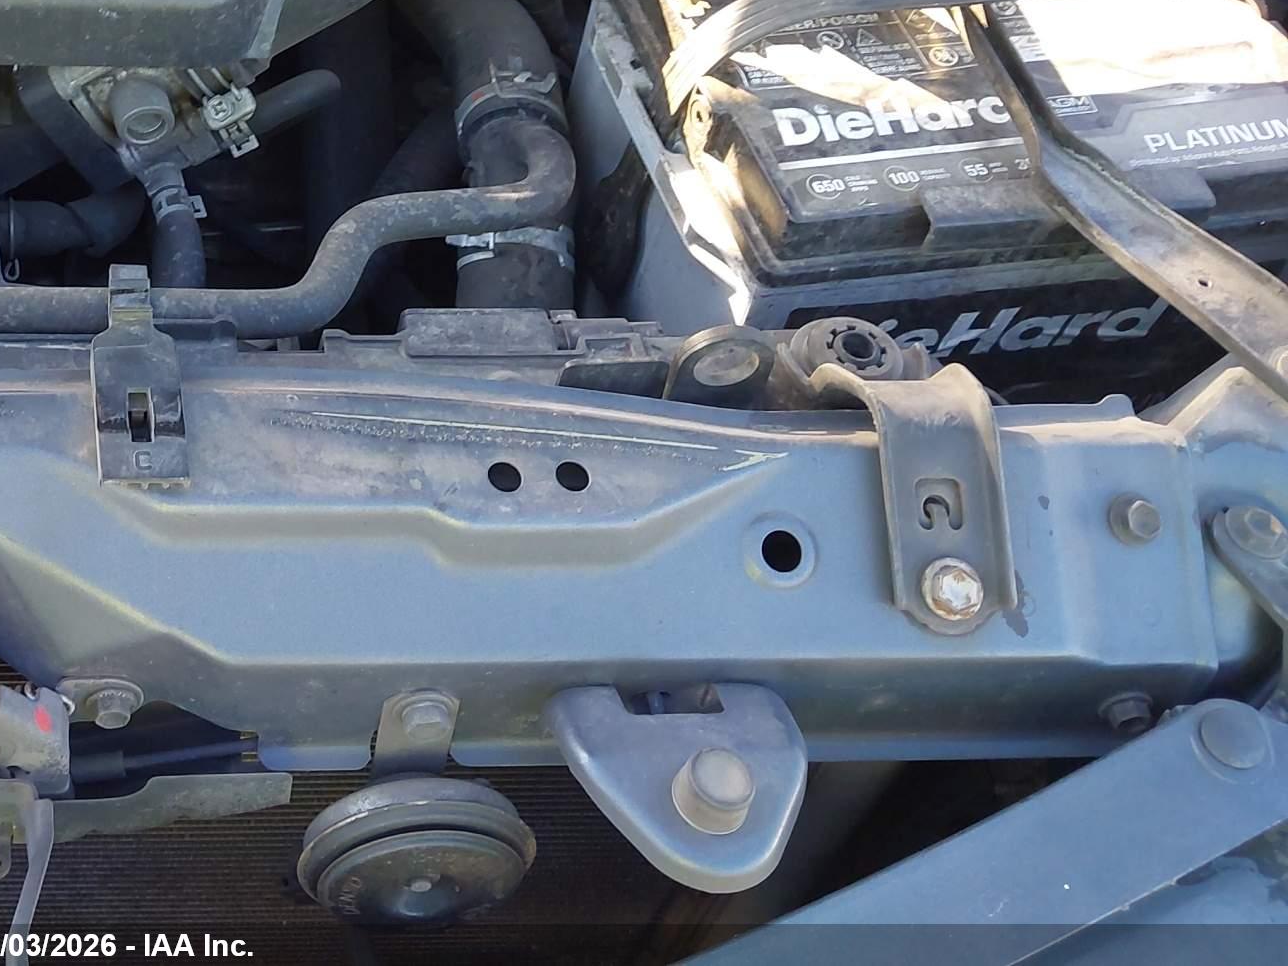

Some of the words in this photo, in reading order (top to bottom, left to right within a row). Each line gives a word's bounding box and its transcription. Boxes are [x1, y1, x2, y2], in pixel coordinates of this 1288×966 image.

[964, 163, 989, 177] 55
[888, 171, 920, 185] 100
[812, 179, 846, 194] 650
[878, 296, 1169, 357] eHard
